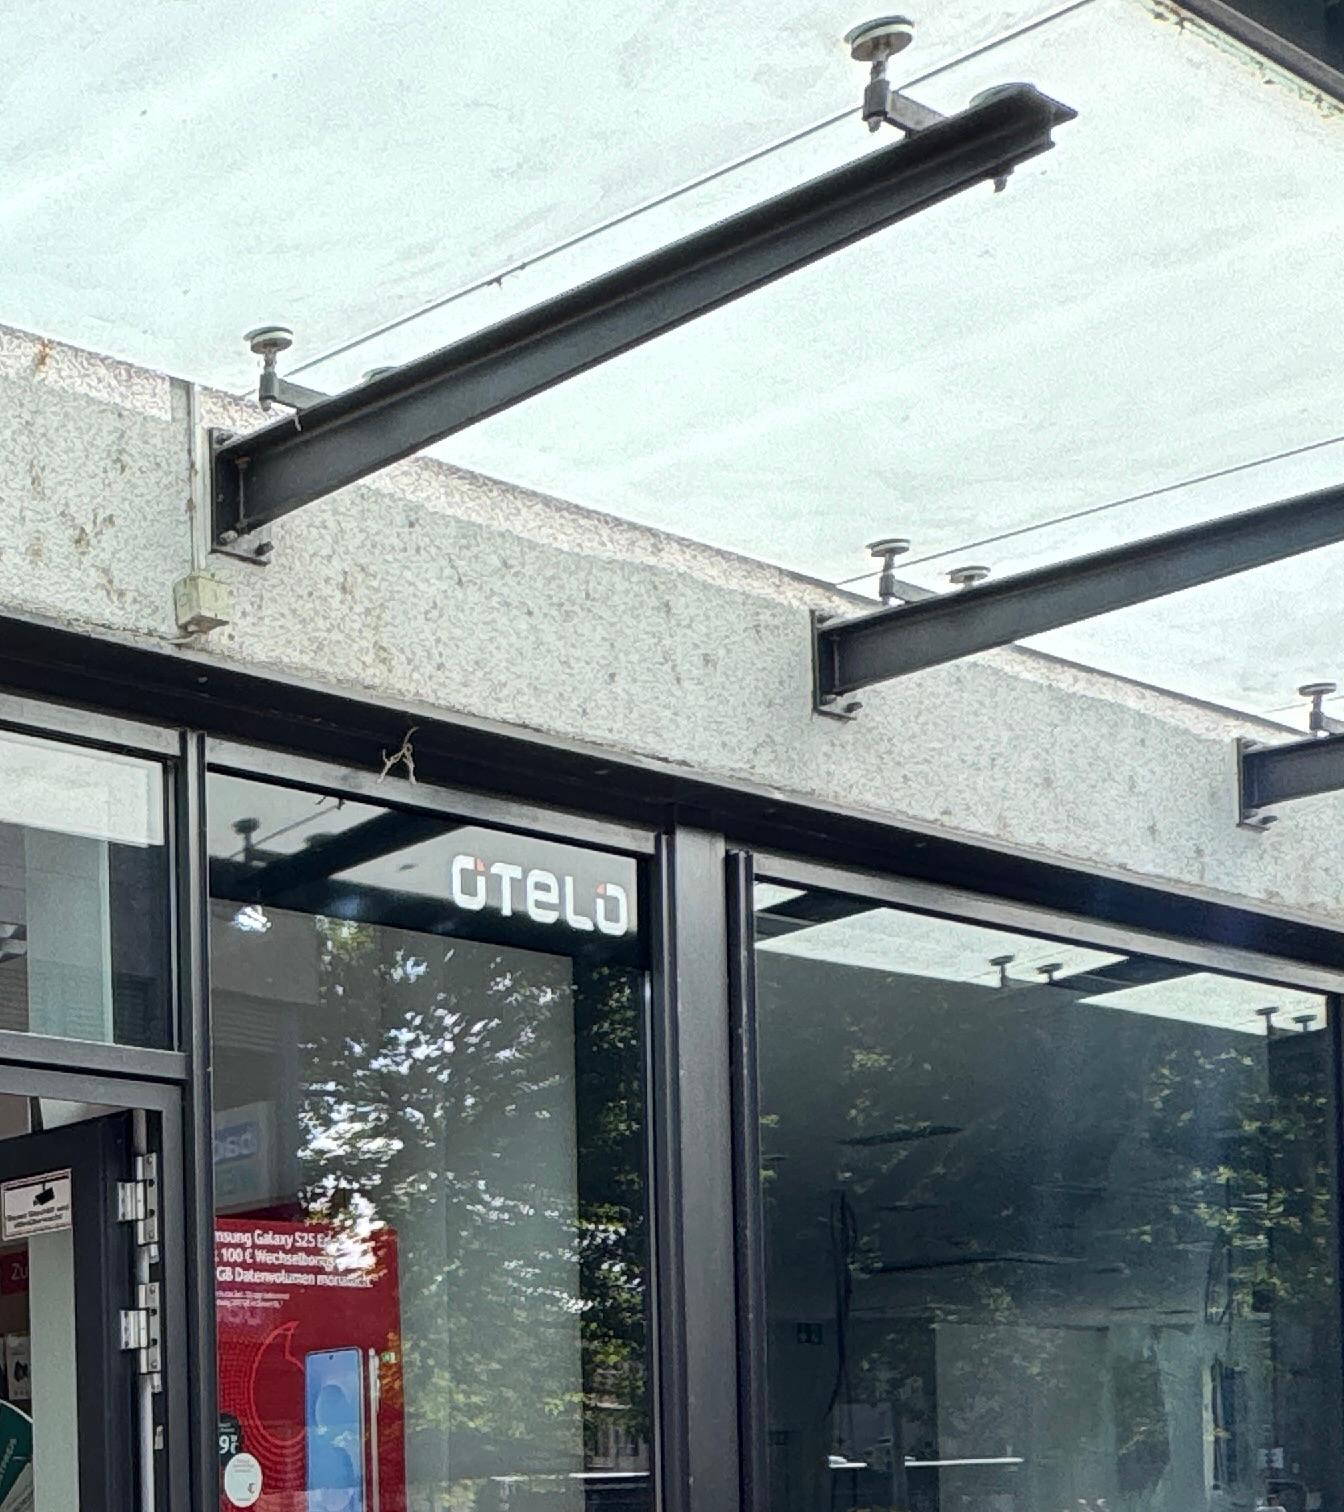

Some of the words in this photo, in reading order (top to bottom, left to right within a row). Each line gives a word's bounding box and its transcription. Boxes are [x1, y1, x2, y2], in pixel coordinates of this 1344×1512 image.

[254, 1229, 294, 1248] Galaxy
[295, 1231, 316, 1248] S25
[221, 1248, 243, 1262] 100
